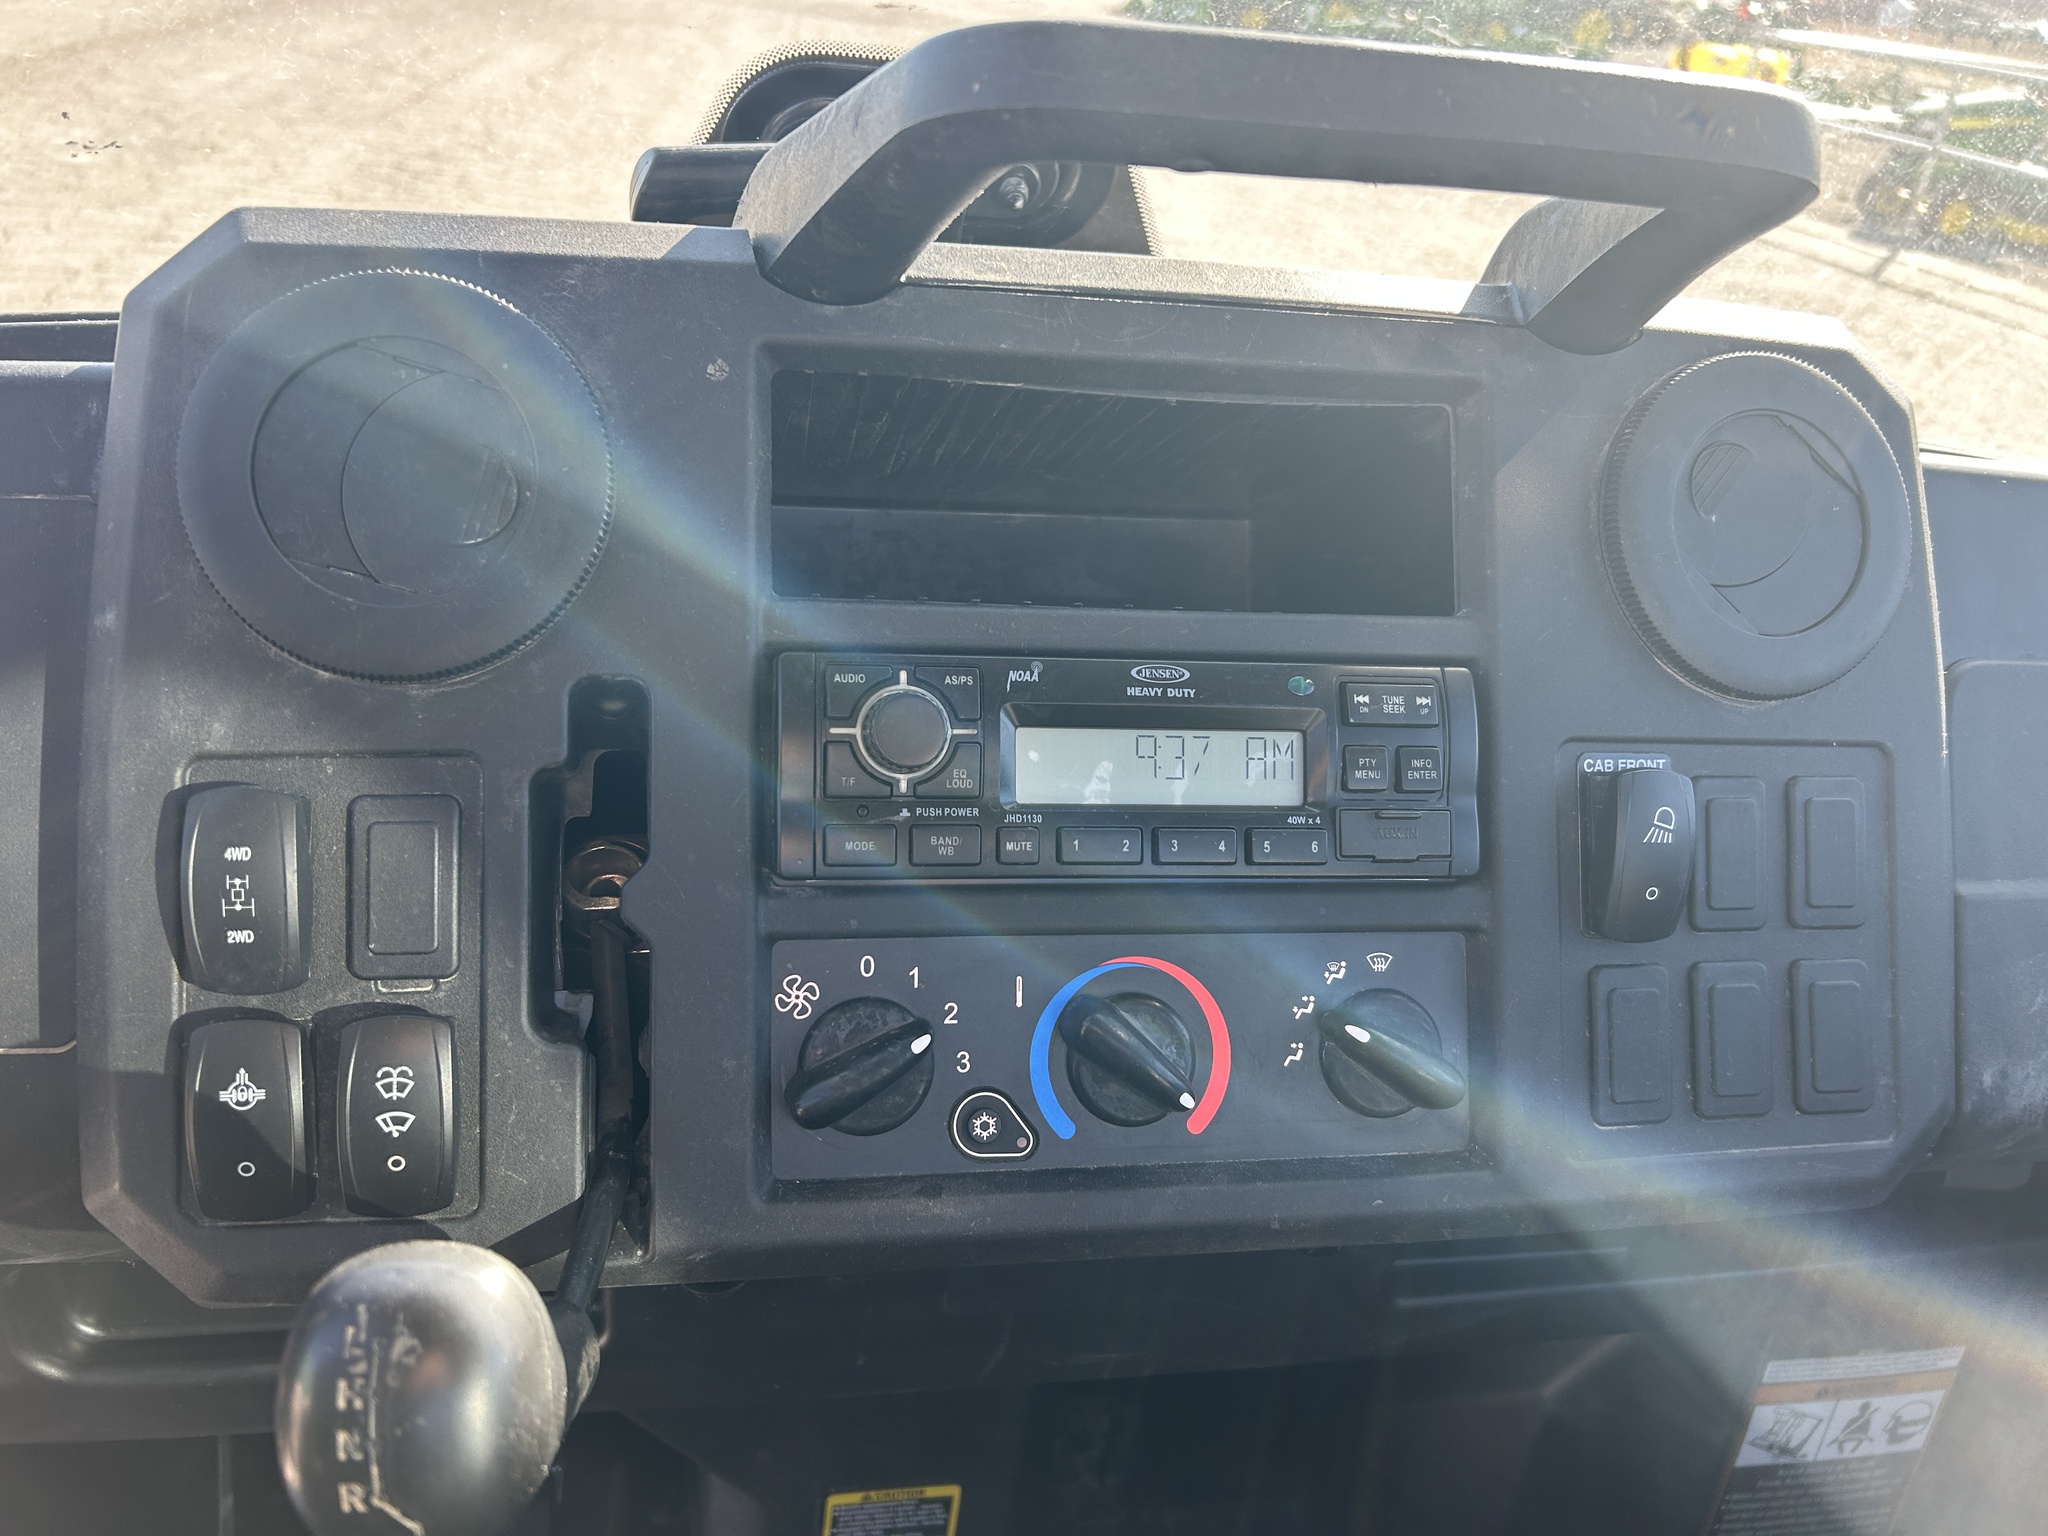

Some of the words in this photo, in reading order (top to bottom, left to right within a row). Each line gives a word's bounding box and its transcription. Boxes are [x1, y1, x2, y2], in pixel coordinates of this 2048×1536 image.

[833, 673, 866, 684] AUDIO
[944, 675, 974, 686] AS/PS
[1007, 668, 1039, 693] NOAA
[1126, 686, 1164, 697] HEAVY
[1166, 687, 1196, 699] DUTY
[1381, 695, 1406, 705] TUNE
[1382, 704, 1406, 714] SEEK
[1419, 707, 1430, 715] UP
[1136, 735, 1211, 780] 9:37
[1246, 736, 1294, 781] AM
[1358, 758, 1377, 768] PTY
[1411, 758, 1432, 768] INFO
[1583, 758, 1615, 773] CAB
[1618, 758, 1666, 772] FRONT
[952, 769, 968, 779] EQ
[1355, 769, 1381, 779] MENU
[1407, 770, 1437, 780] ENTER
[841, 777, 856, 787] T/F
[946, 778, 974, 789] LOUD
[916, 807, 942, 817] PUSH
[944, 807, 980, 818] POWER
[1003, 813, 1043, 824] JHD1130
[1287, 815, 1306, 825] 40W
[1314, 816, 1321, 825] 4
[845, 841, 876, 851] MODE
[938, 846, 955, 856] WB
[1006, 841, 1033, 851] MUTE
[1073, 839, 1080, 852] 1
[1122, 839, 1130, 852] 2
[1171, 840, 1179, 852] 3
[1218, 840, 1226, 853] 4
[1263, 841, 1271, 853] 5
[1311, 841, 1319, 853] 6
[223, 846, 252, 861] 4WD
[226, 930, 255, 944] 2WD
[859, 955, 876, 978] 0
[908, 966, 919, 989] 1
[943, 1002, 959, 1025] 2
[955, 1051, 971, 1074] 3
[337, 1482, 369, 1514] R
